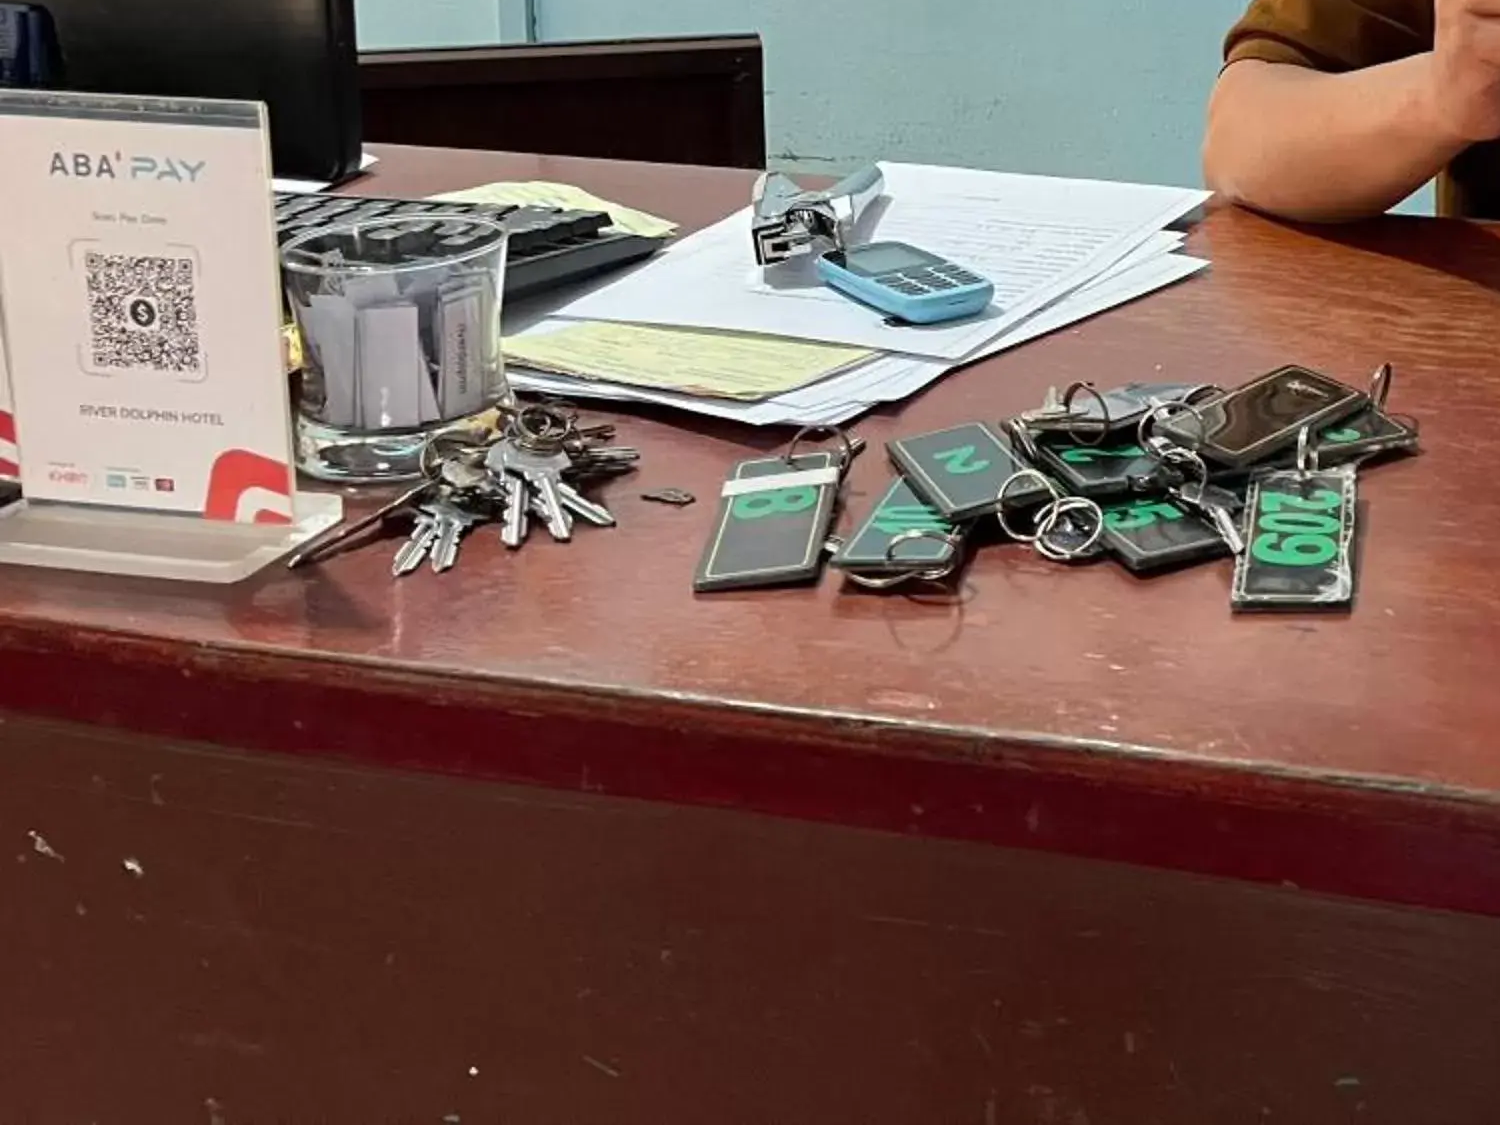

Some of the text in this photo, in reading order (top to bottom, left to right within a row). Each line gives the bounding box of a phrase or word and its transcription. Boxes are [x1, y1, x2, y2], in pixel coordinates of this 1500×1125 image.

[130, 156, 206, 182] PAY
[79, 404, 225, 426] RIVER DOLPHIN HOTEL
[1252, 489, 1344, 566] 209
